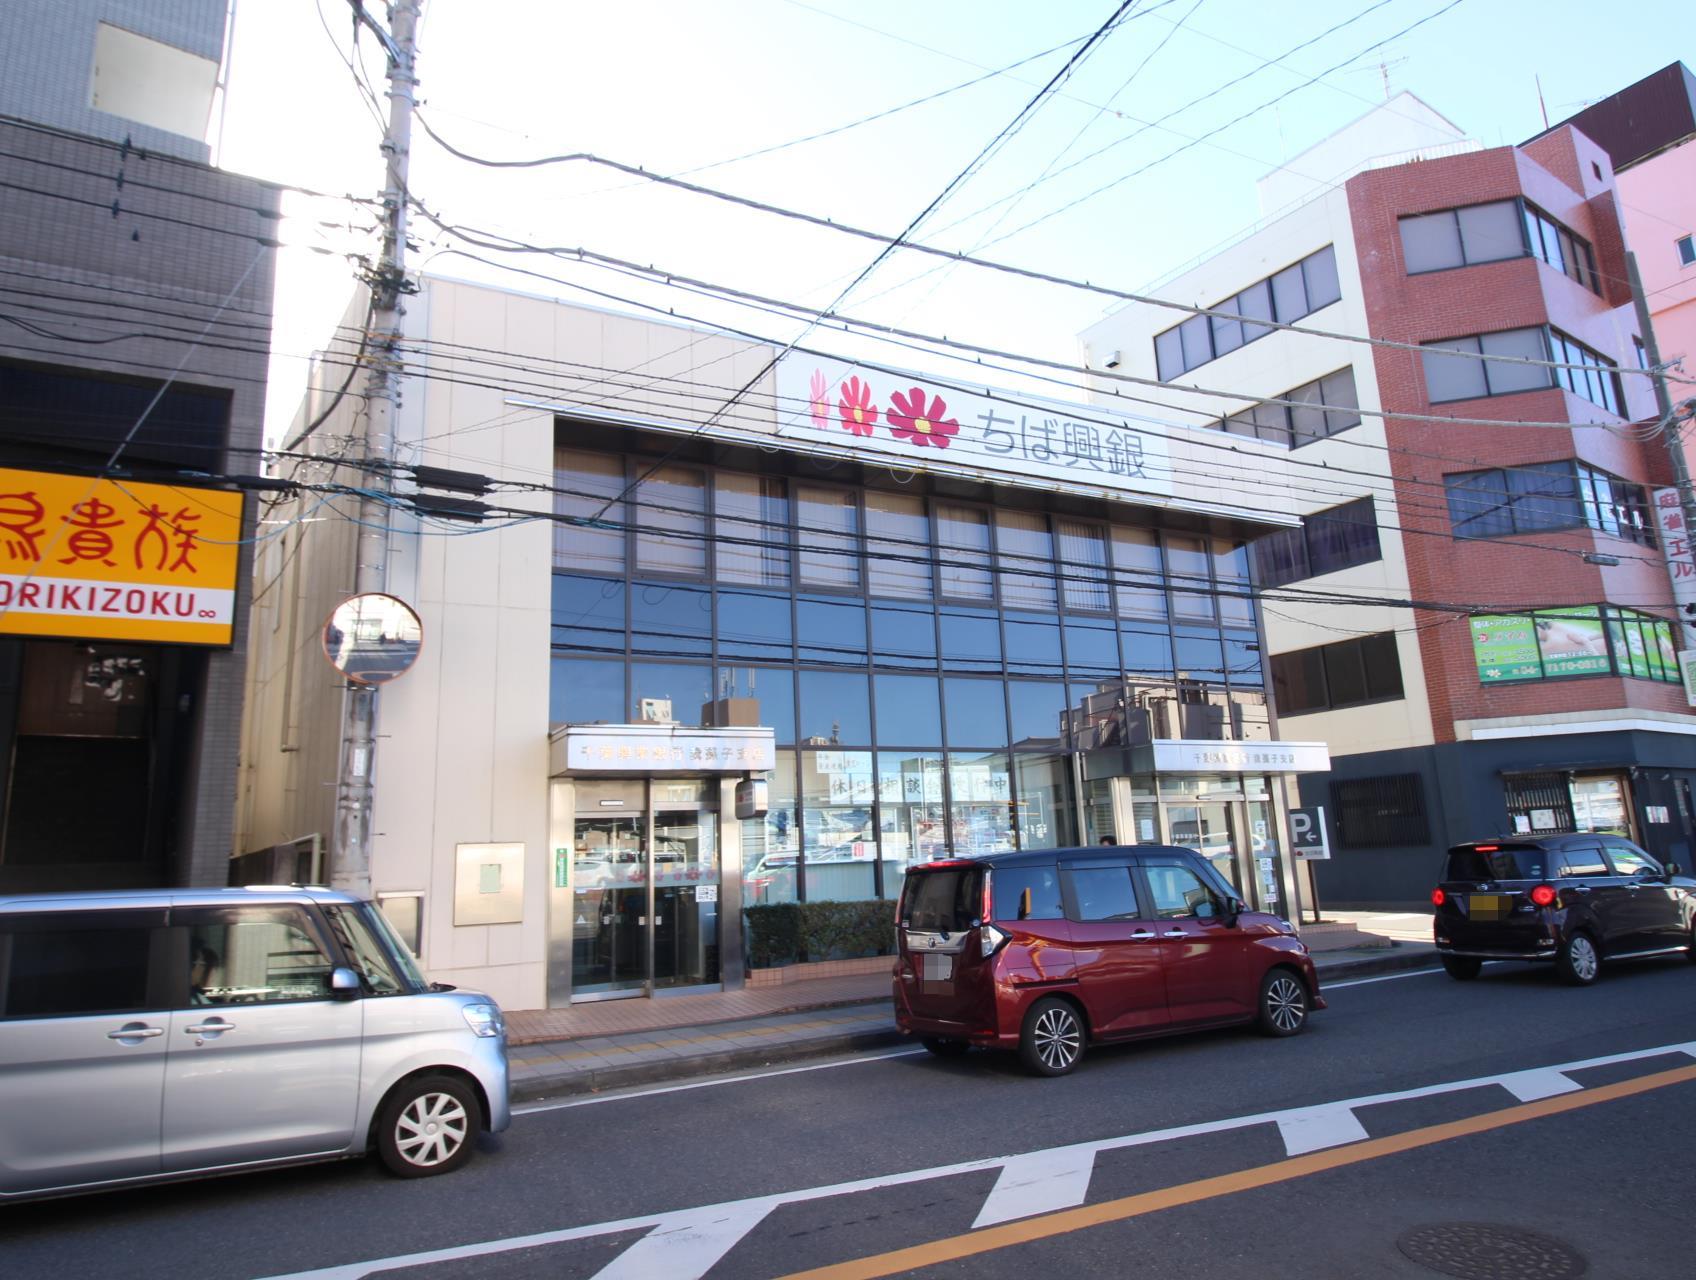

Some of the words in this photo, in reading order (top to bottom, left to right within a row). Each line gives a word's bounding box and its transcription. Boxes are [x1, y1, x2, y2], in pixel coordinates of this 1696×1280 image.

[976, 408, 1147, 479] ちば興銀
[0, 490, 202, 574] 鳥貴族
[1289, 813, 1312, 843] P
